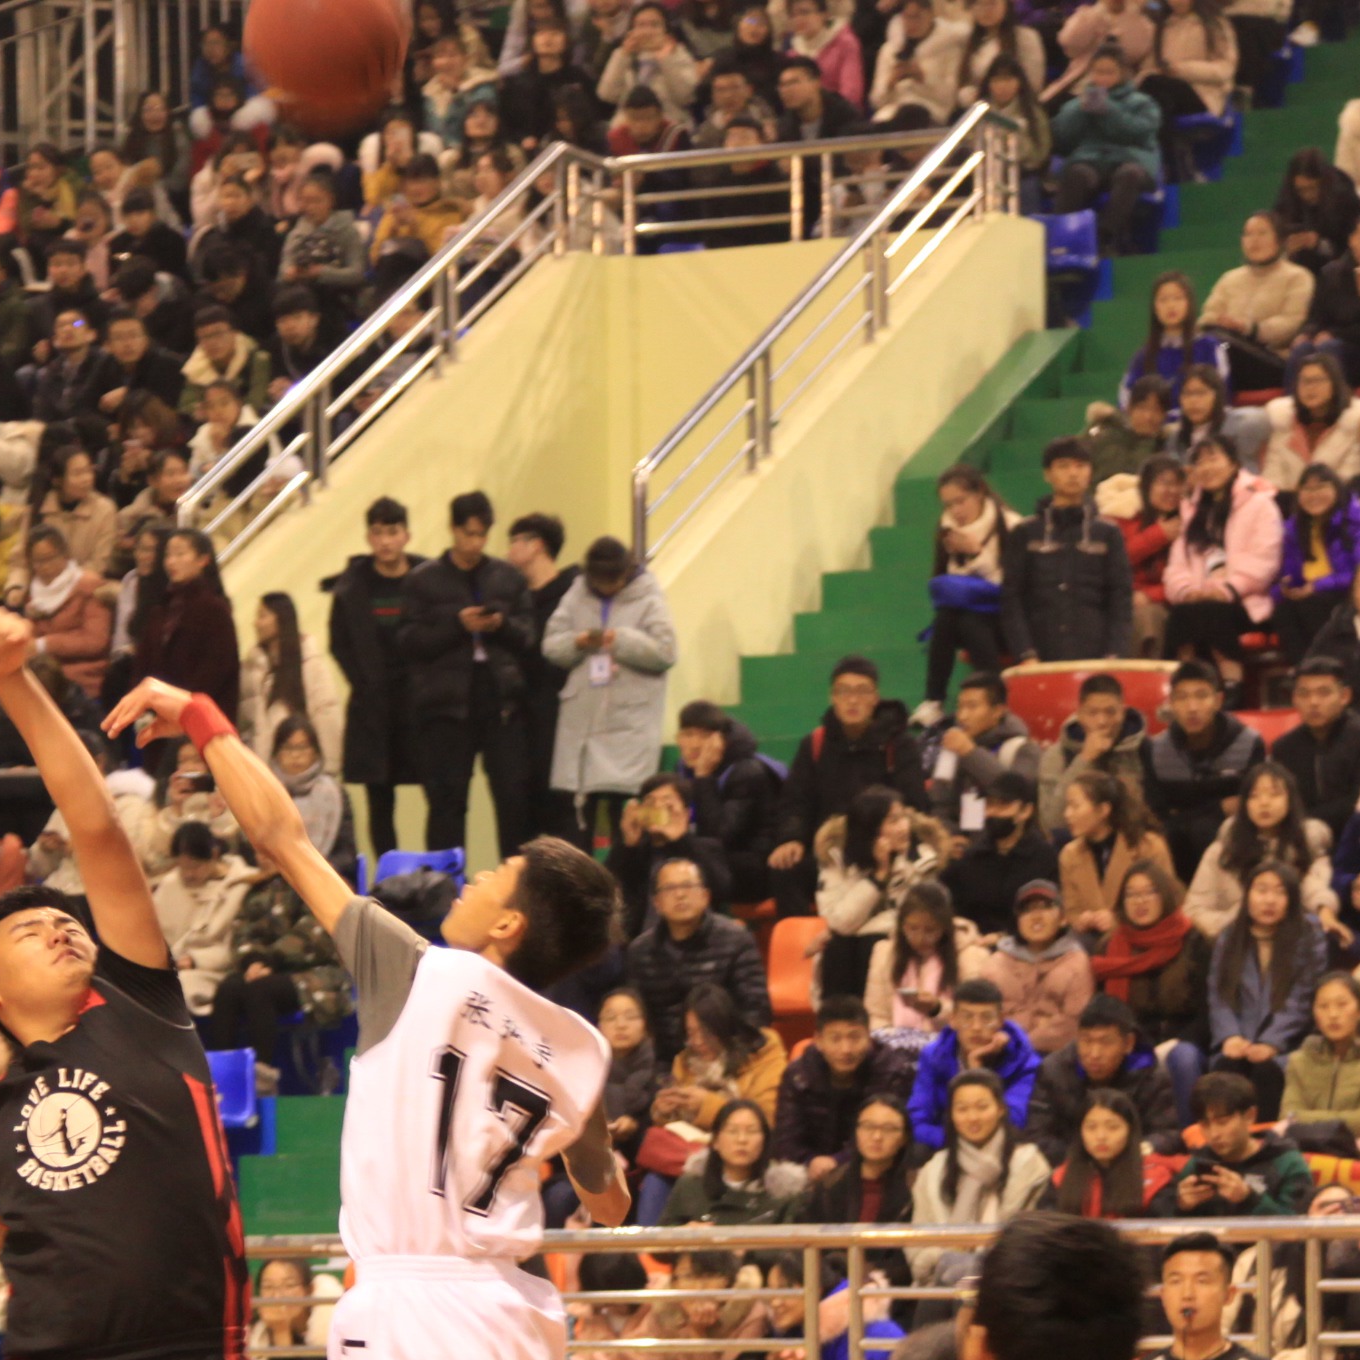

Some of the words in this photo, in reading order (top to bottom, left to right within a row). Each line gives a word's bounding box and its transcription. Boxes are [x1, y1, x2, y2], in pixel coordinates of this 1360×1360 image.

[13, 1076, 50, 1131] LOVE
[58, 1068, 111, 1101] LIFE
[429, 1044, 552, 1218] 17
[17, 1120, 127, 1191] BASKETBALL
